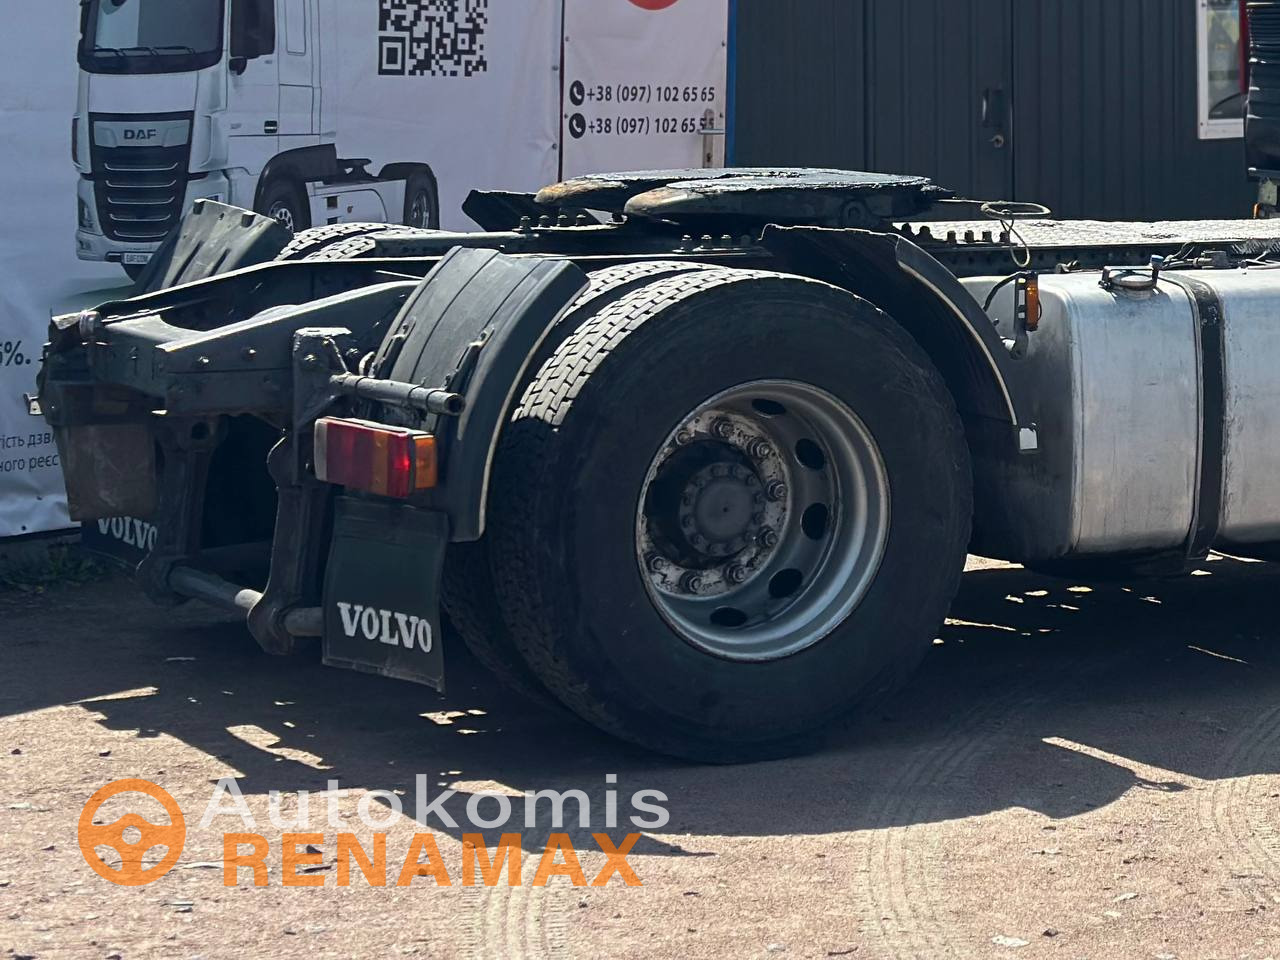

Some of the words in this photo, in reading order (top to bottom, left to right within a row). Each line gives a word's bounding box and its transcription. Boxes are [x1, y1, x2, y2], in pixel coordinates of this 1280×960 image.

[587, 86, 612, 101] +38
[617, 85, 651, 103] (097)
[656, 86, 679, 102] 102
[682, 86, 698, 102] 65
[701, 87, 715, 102] 65
[123, 128, 157, 140] DAF
[588, 118, 612, 134] +38
[616, 117, 650, 135] (097)
[655, 118, 677, 134] 102
[681, 118, 696, 133] 65
[98, 516, 158, 552] VOLVO
[337, 601, 432, 653] VOLVO
